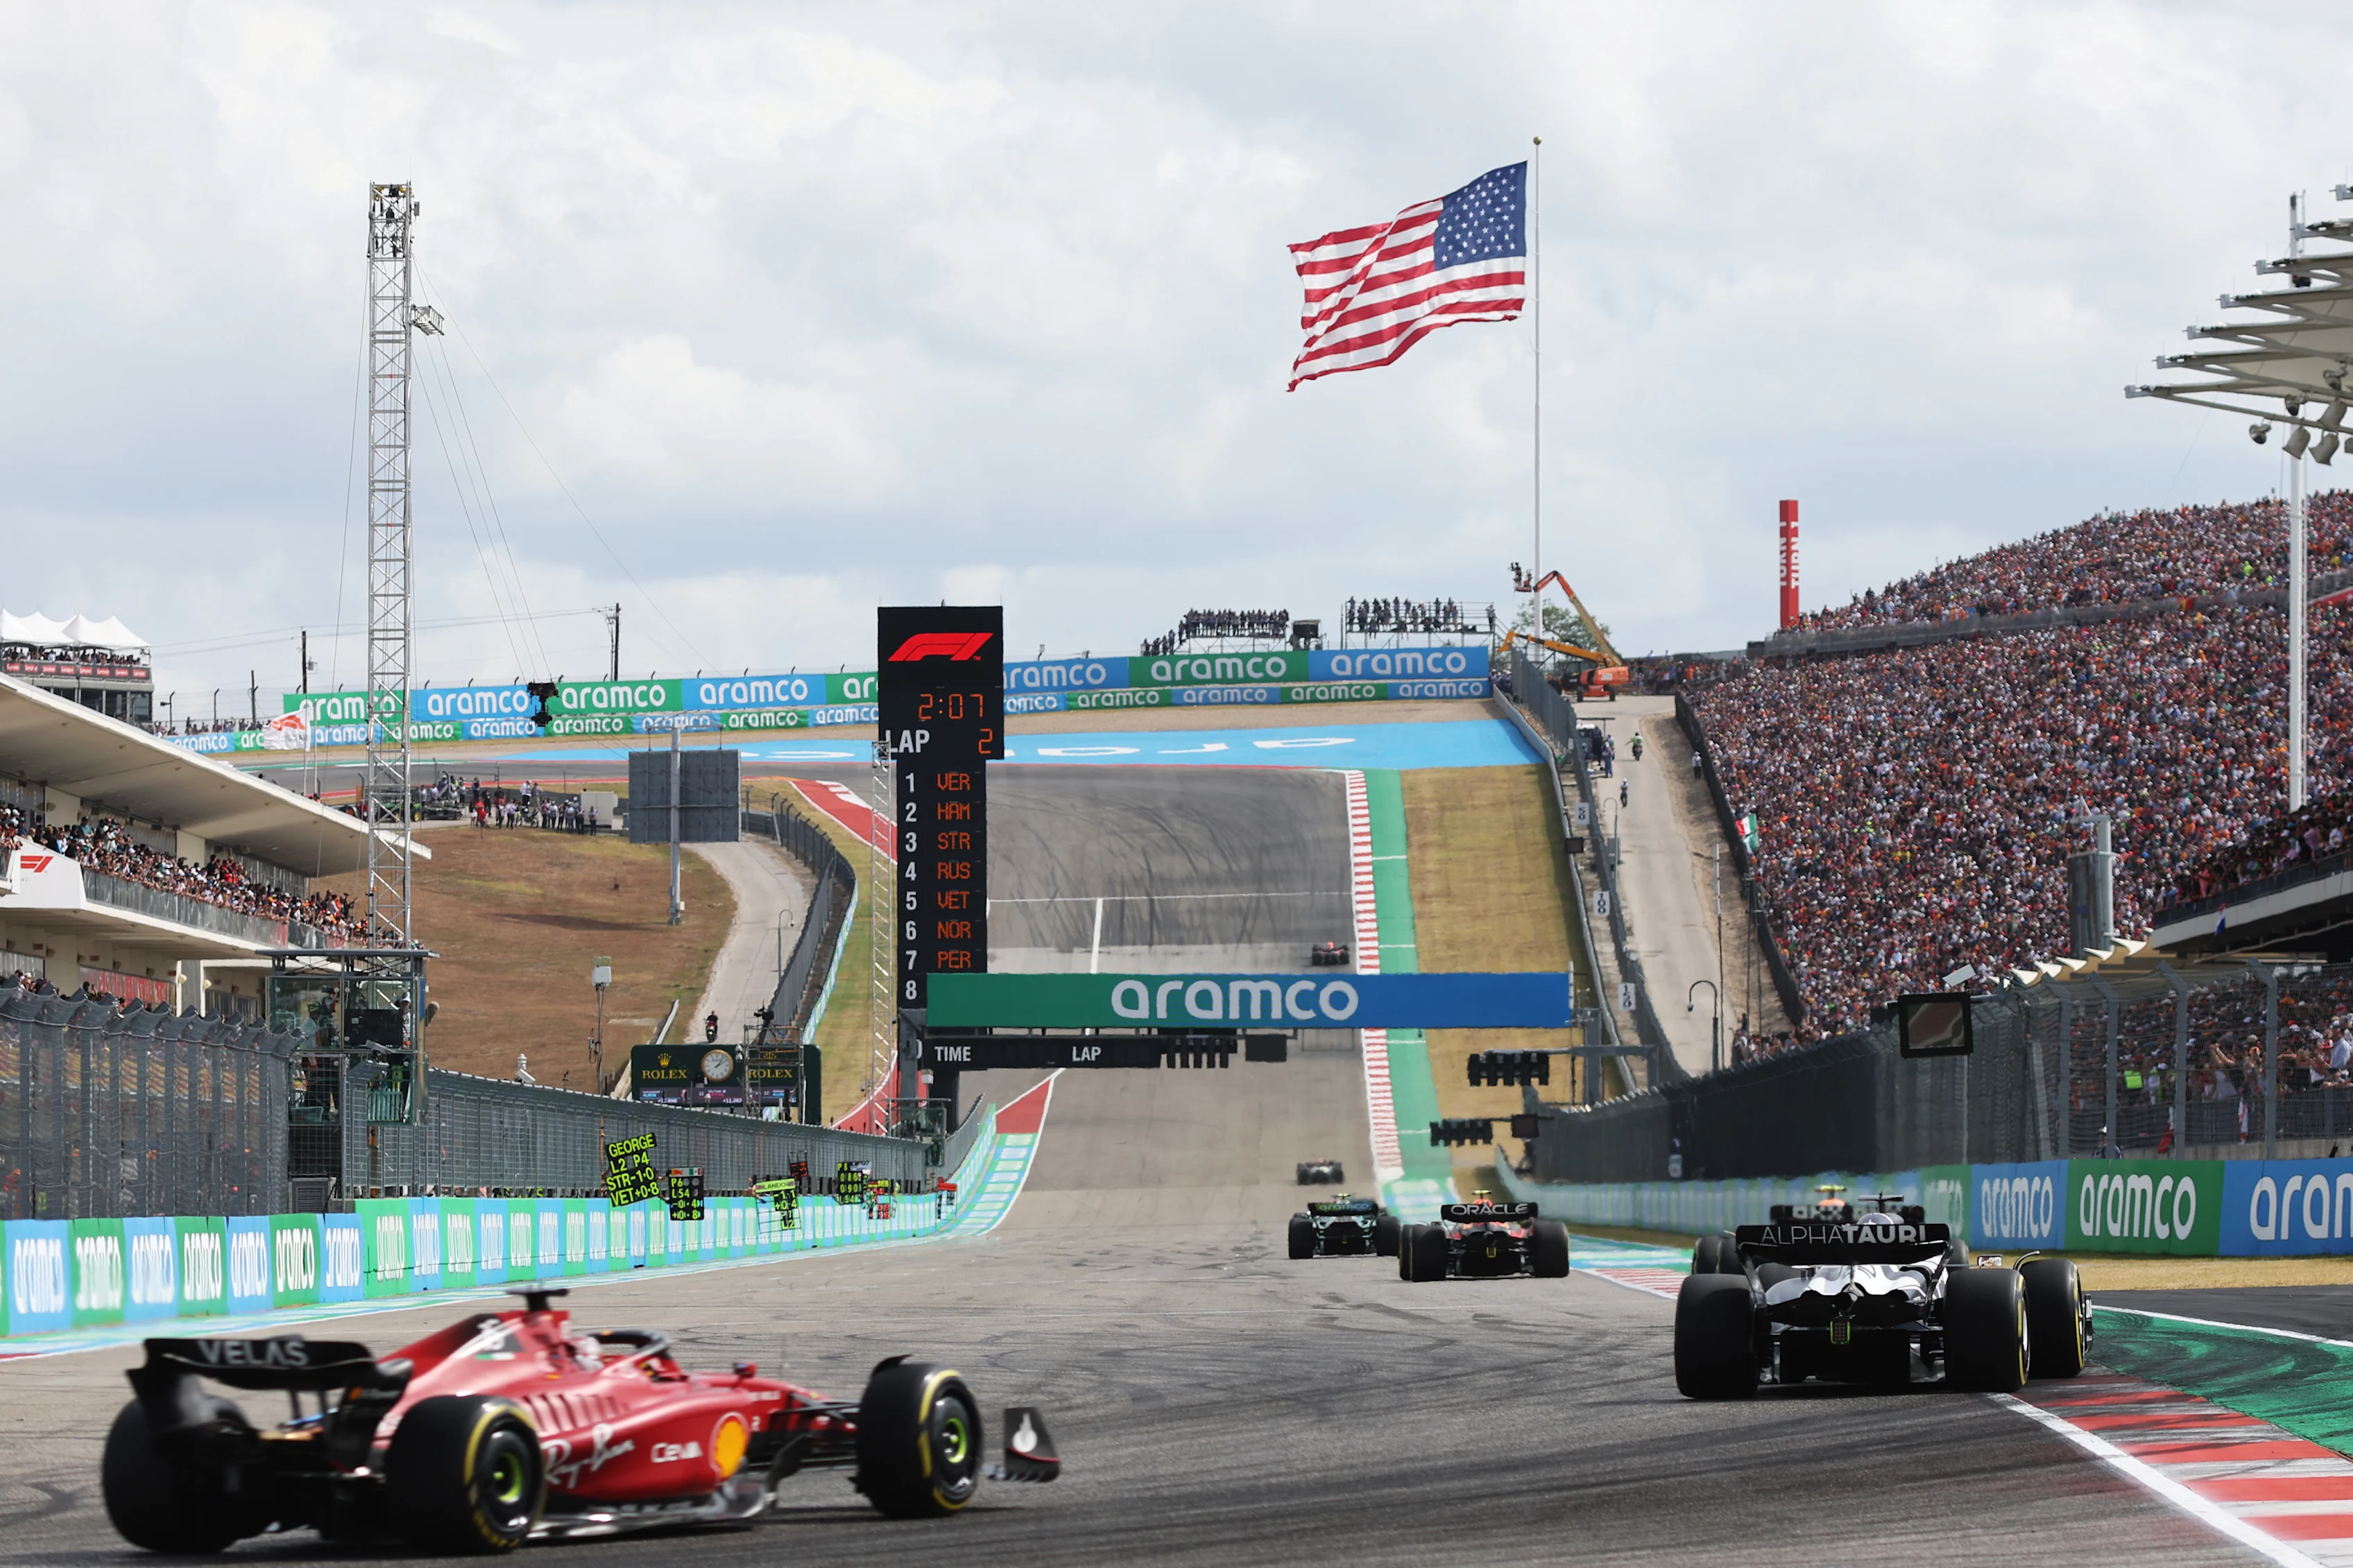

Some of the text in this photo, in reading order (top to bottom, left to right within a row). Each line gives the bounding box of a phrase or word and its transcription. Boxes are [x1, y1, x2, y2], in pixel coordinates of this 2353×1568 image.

[1151, 656, 1287, 680] aramco
[1330, 651, 1466, 675] aramco
[1003, 663, 1106, 689] ramco
[561, 684, 666, 709] aramco
[699, 678, 808, 704] aramco
[1183, 686, 1268, 703] aramco
[1291, 683, 1376, 701] aramco
[1399, 680, 1483, 698] aramco
[427, 691, 528, 716] aramco
[918, 693, 984, 719] 2:07
[1077, 690, 1159, 709] aramco
[553, 717, 623, 734] aramco
[728, 710, 798, 728] aramco
[885, 728, 993, 755] LAP 2
[905, 773, 970, 793] 1 VER
[905, 802, 970, 822] 2 HAM
[905, 832, 970, 852] 3 STR
[905, 862, 970, 881] 4 RUS
[905, 891, 970, 911] 5 VET
[905, 920, 970, 940] 6 NOR
[905, 950, 970, 970] 7 PER
[905, 980, 918, 1000] 8
[1111, 979, 1358, 1021] aramco
[935, 1046, 1101, 1062] TIME LAP
[642, 1069, 687, 1080] ROLEX
[748, 1069, 793, 1079] ROLEX
[608, 1133, 655, 1157] GEORGE
[610, 1151, 650, 1173] L2 P4
[837, 1162, 848, 1171] P8
[671, 1178, 683, 1187] P6
[764, 1182, 787, 1190] LANDO
[671, 1188, 690, 1198] L54
[1319, 1203, 1371, 1212] aramco
[1451, 1203, 1528, 1215] ORACLE
[1981, 1176, 2053, 1239] aramco
[2080, 1174, 2196, 1240] aramco
[781, 1220, 795, 1230] L2
[183, 1232, 223, 1301] aramco
[230, 1231, 268, 1298] aramco
[275, 1227, 316, 1293] aramco
[196, 1339, 309, 1367] VELAS
